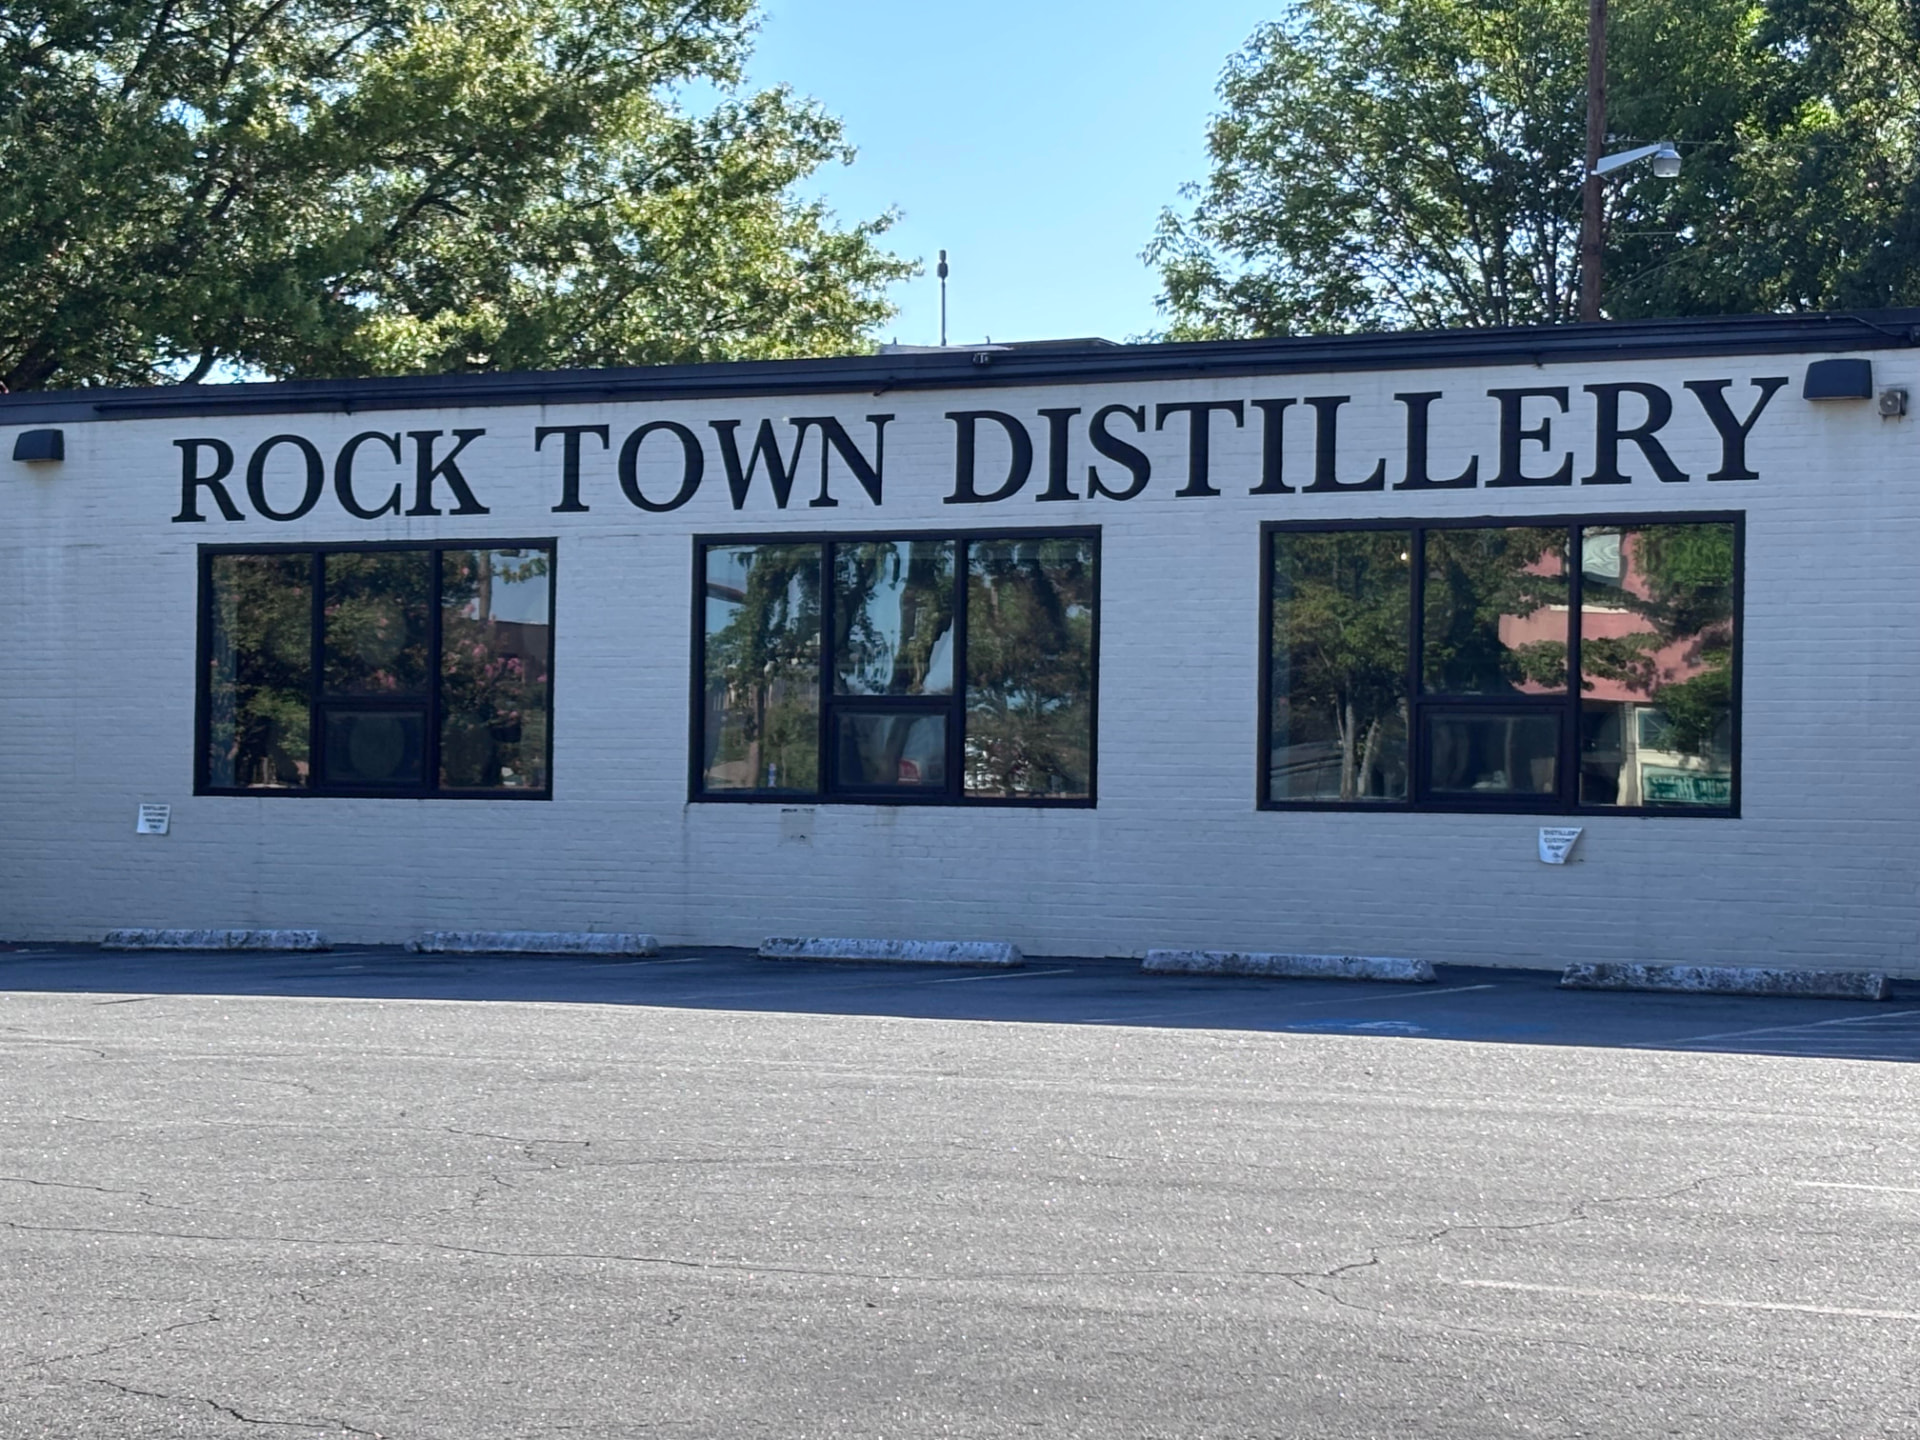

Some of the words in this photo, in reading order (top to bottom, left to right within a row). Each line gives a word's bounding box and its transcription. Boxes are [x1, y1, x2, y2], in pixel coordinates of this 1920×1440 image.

[171, 428, 491, 524] ROCK
[534, 413, 896, 513] TOWN
[942, 376, 1789, 505] DISTILLERY
